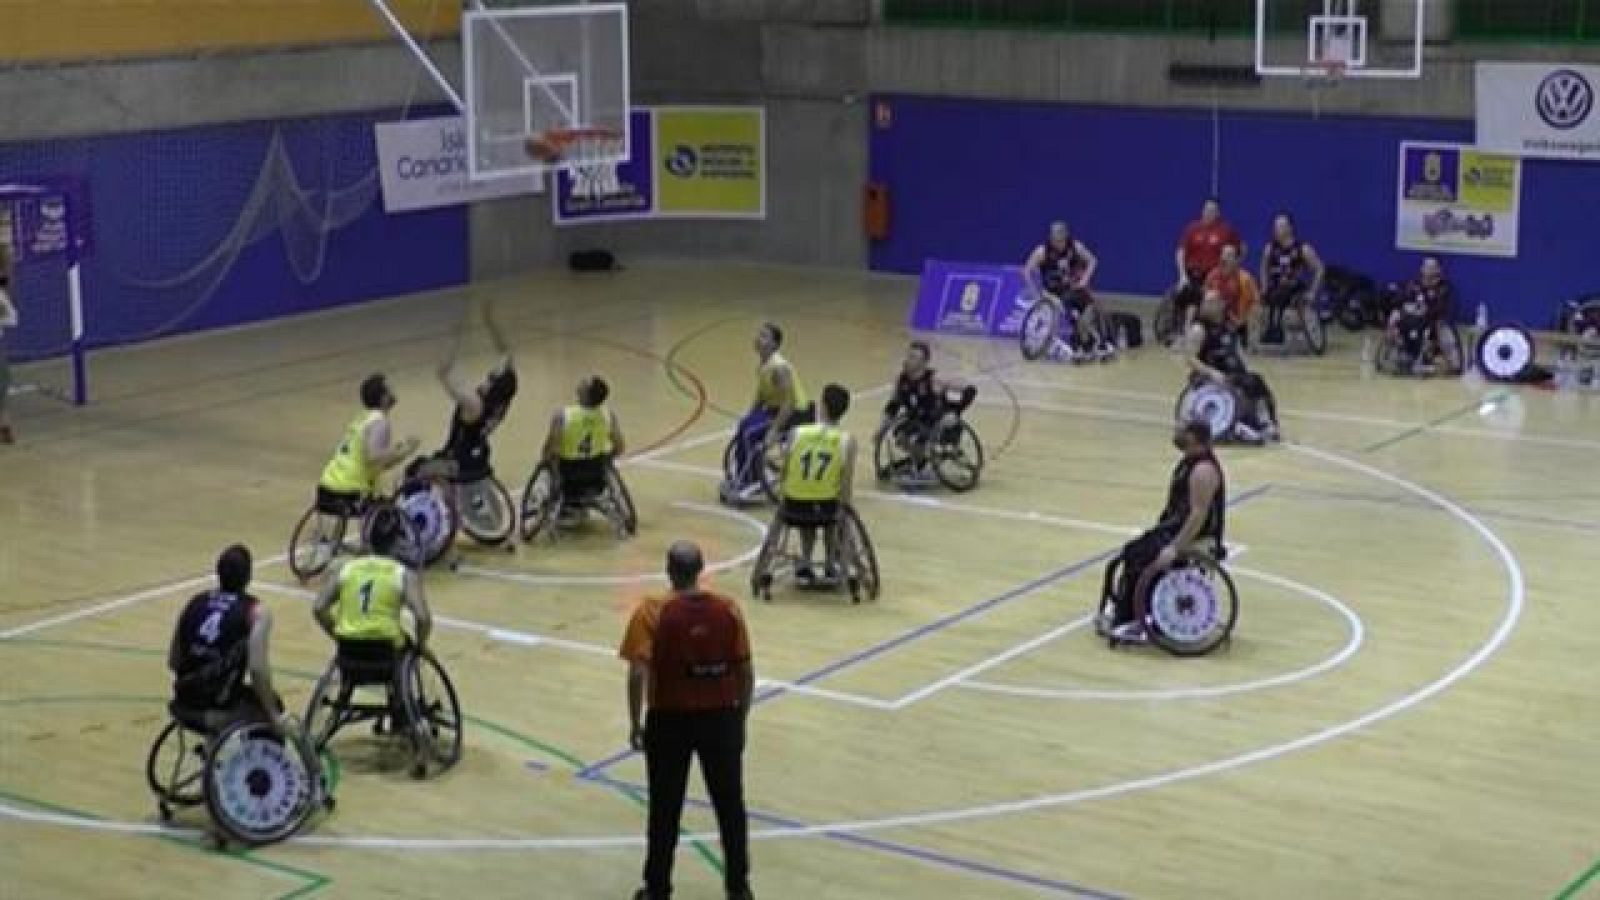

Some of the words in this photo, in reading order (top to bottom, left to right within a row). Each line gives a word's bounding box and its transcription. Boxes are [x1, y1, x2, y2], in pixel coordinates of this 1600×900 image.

[799, 449, 833, 482] 17
[359, 578, 375, 615] 1
[199, 610, 223, 643] 4
